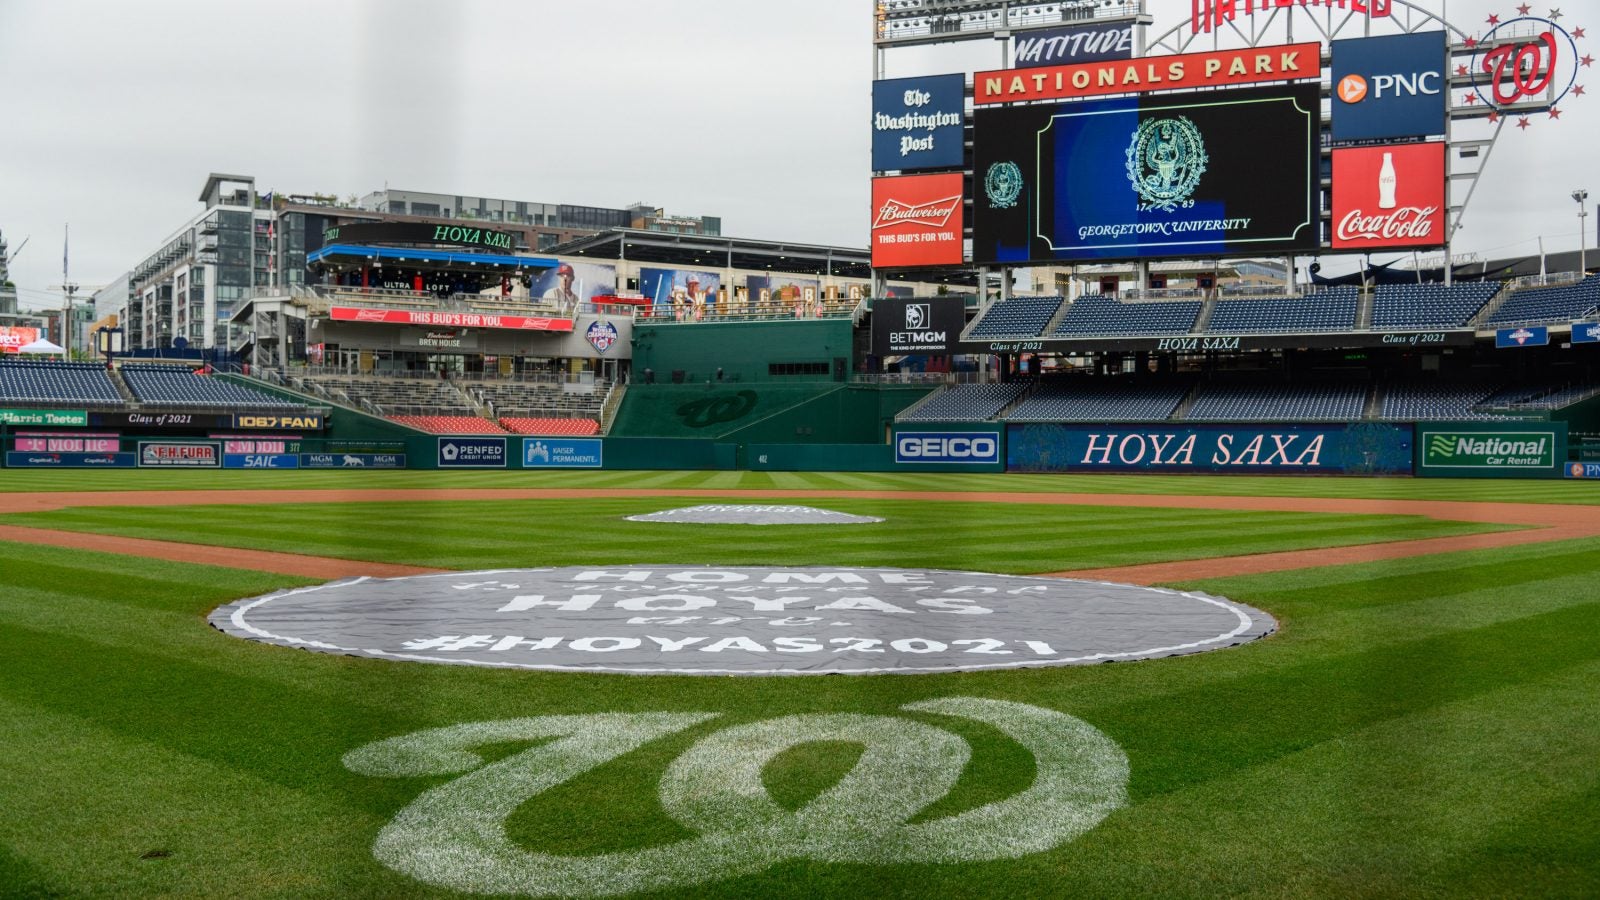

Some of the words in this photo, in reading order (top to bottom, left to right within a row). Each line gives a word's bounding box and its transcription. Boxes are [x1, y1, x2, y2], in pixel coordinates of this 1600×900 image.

[1016, 28, 1132, 62] NATITUDE
[985, 62, 1185, 96] NATIONALS
[1205, 52, 1300, 78] PARK
[1371, 71, 1440, 98] PNC
[904, 88, 931, 107] The
[875, 111, 960, 131] Washington
[900, 134, 934, 156] Post
[880, 205, 953, 221] Budweiser
[1078, 221, 1172, 240] GEORGETOWN
[1172, 218, 1251, 235] UNIVERSITY
[1338, 206, 1438, 240] Coca-Cola
[433, 226, 480, 243] HOYA
[484, 231, 511, 249] SAXA
[879, 235, 896, 244] THIS
[897, 233, 920, 243] BUD'S
[921, 233, 936, 242] FOR
[938, 232, 955, 241] YOU.
[384, 281, 410, 290] ULTRA
[409, 312, 431, 322] THIS
[433, 313, 460, 325] BUD'S
[462, 315, 480, 325] FOR
[482, 316, 503, 327] YOU.
[419, 338, 438, 346] BREW
[439, 339, 460, 347] HOUSE
[889, 331, 946, 343] BETMGM
[1158, 338, 1197, 350] HOYA
[1202, 337, 1241, 350] SAXA
[1382, 334, 1406, 344] Class
[1408, 333, 1419, 345] of
[1421, 333, 1446, 343] 2021
[991, 342, 1010, 350] Class
[1013, 342, 1021, 352] of
[1022, 342, 1042, 350] 2021
[3, 412, 42, 423] Harris
[45, 414, 84, 424] Teeter
[128, 414, 153, 424] Class
[156, 414, 166, 425] of
[168, 415, 192, 424] 2021
[281, 417, 318, 428] FAN
[460, 446, 501, 454] PENFED
[899, 437, 995, 457] GEICO
[1081, 434, 1197, 464] HOYA
[1212, 434, 1324, 465] SAXA
[243, 455, 278, 467] SAIC
[310, 455, 333, 463] MGM
[374, 455, 396, 463] MGM
[1486, 457, 1504, 465] Car
[1507, 456, 1541, 465] Rental
[573, 571, 935, 584] HOME
[496, 594, 994, 615] HOYAS
[402, 634, 1058, 656] #HOYAS2021
